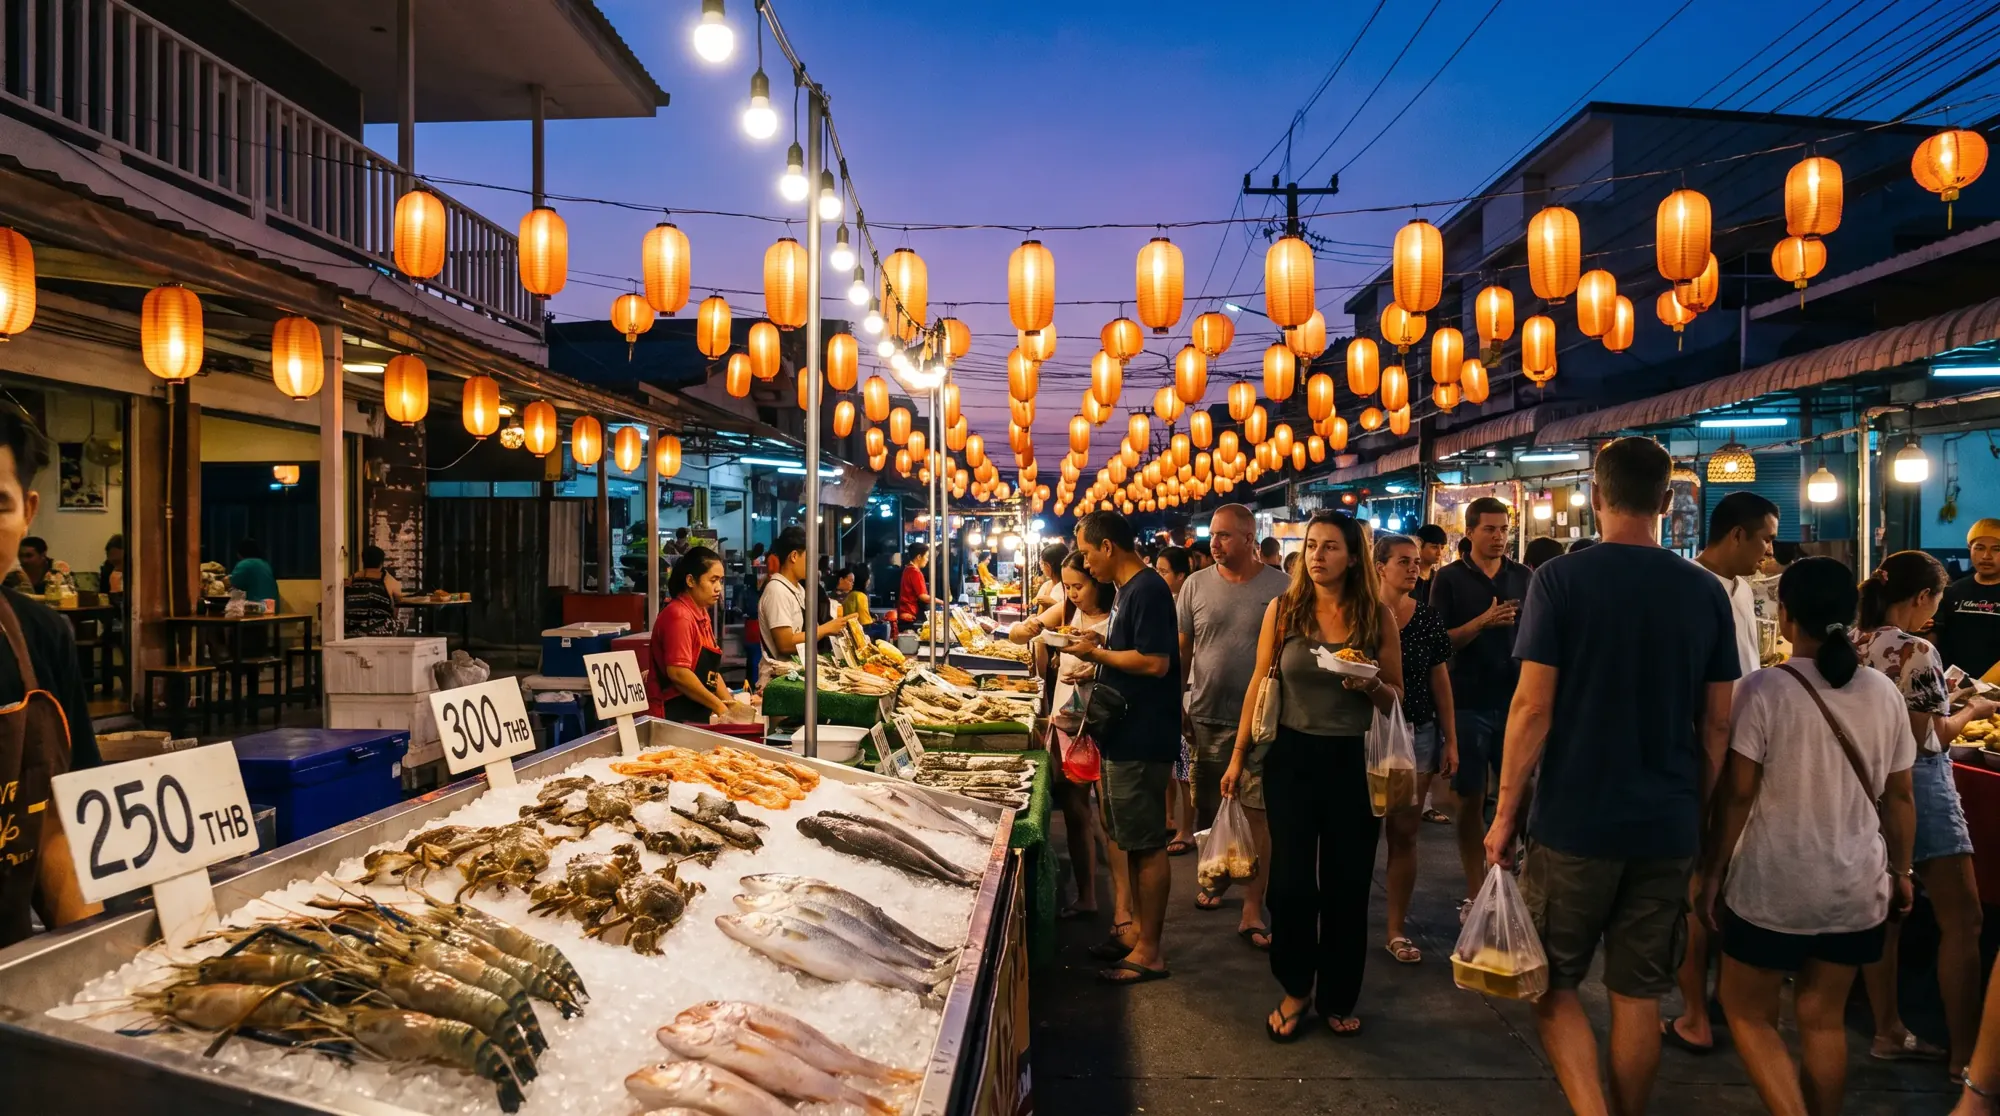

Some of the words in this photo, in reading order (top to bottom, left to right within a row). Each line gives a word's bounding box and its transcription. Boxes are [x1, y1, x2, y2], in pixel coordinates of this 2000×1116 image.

[591, 661, 629, 709] 300
[627, 682, 646, 702] THB
[442, 694, 502, 760] 300
[502, 718, 530, 743] THB
[76, 774, 196, 880] 250
[198, 804, 249, 846] THB
